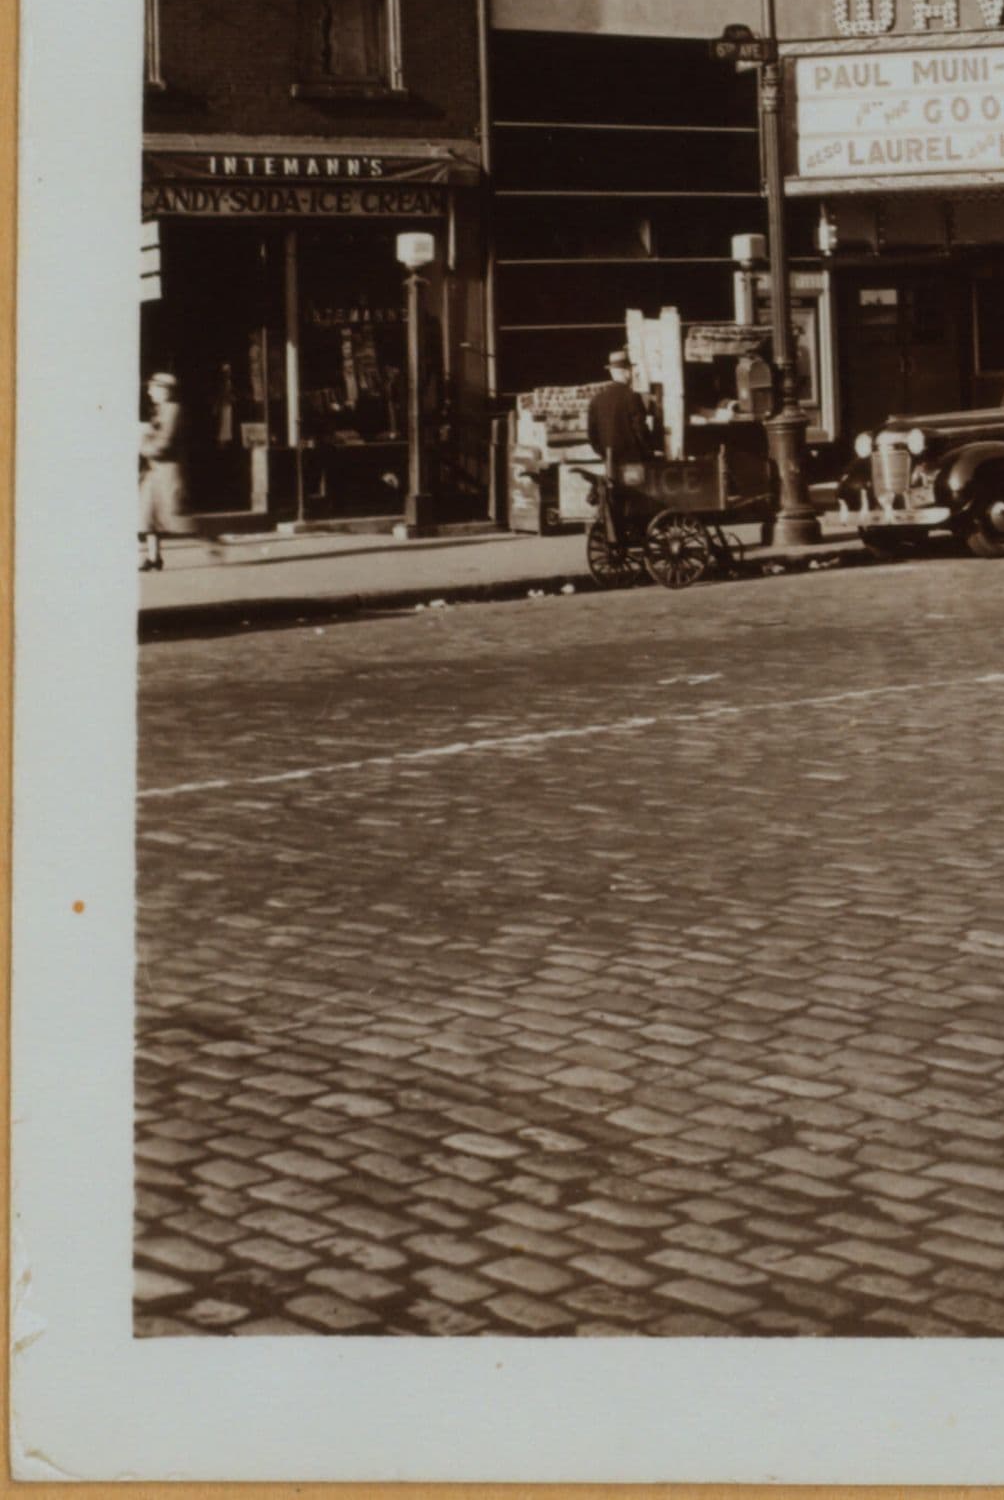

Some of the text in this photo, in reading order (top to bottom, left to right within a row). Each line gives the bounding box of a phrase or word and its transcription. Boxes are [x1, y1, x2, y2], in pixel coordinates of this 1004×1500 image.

[814, 61, 890, 91] PAUL
[804, 140, 843, 169] ALSO
[847, 135, 962, 166] LAUREL
[209, 155, 384, 177] INTEMANN'S
[360, 188, 448, 213] CREAM
